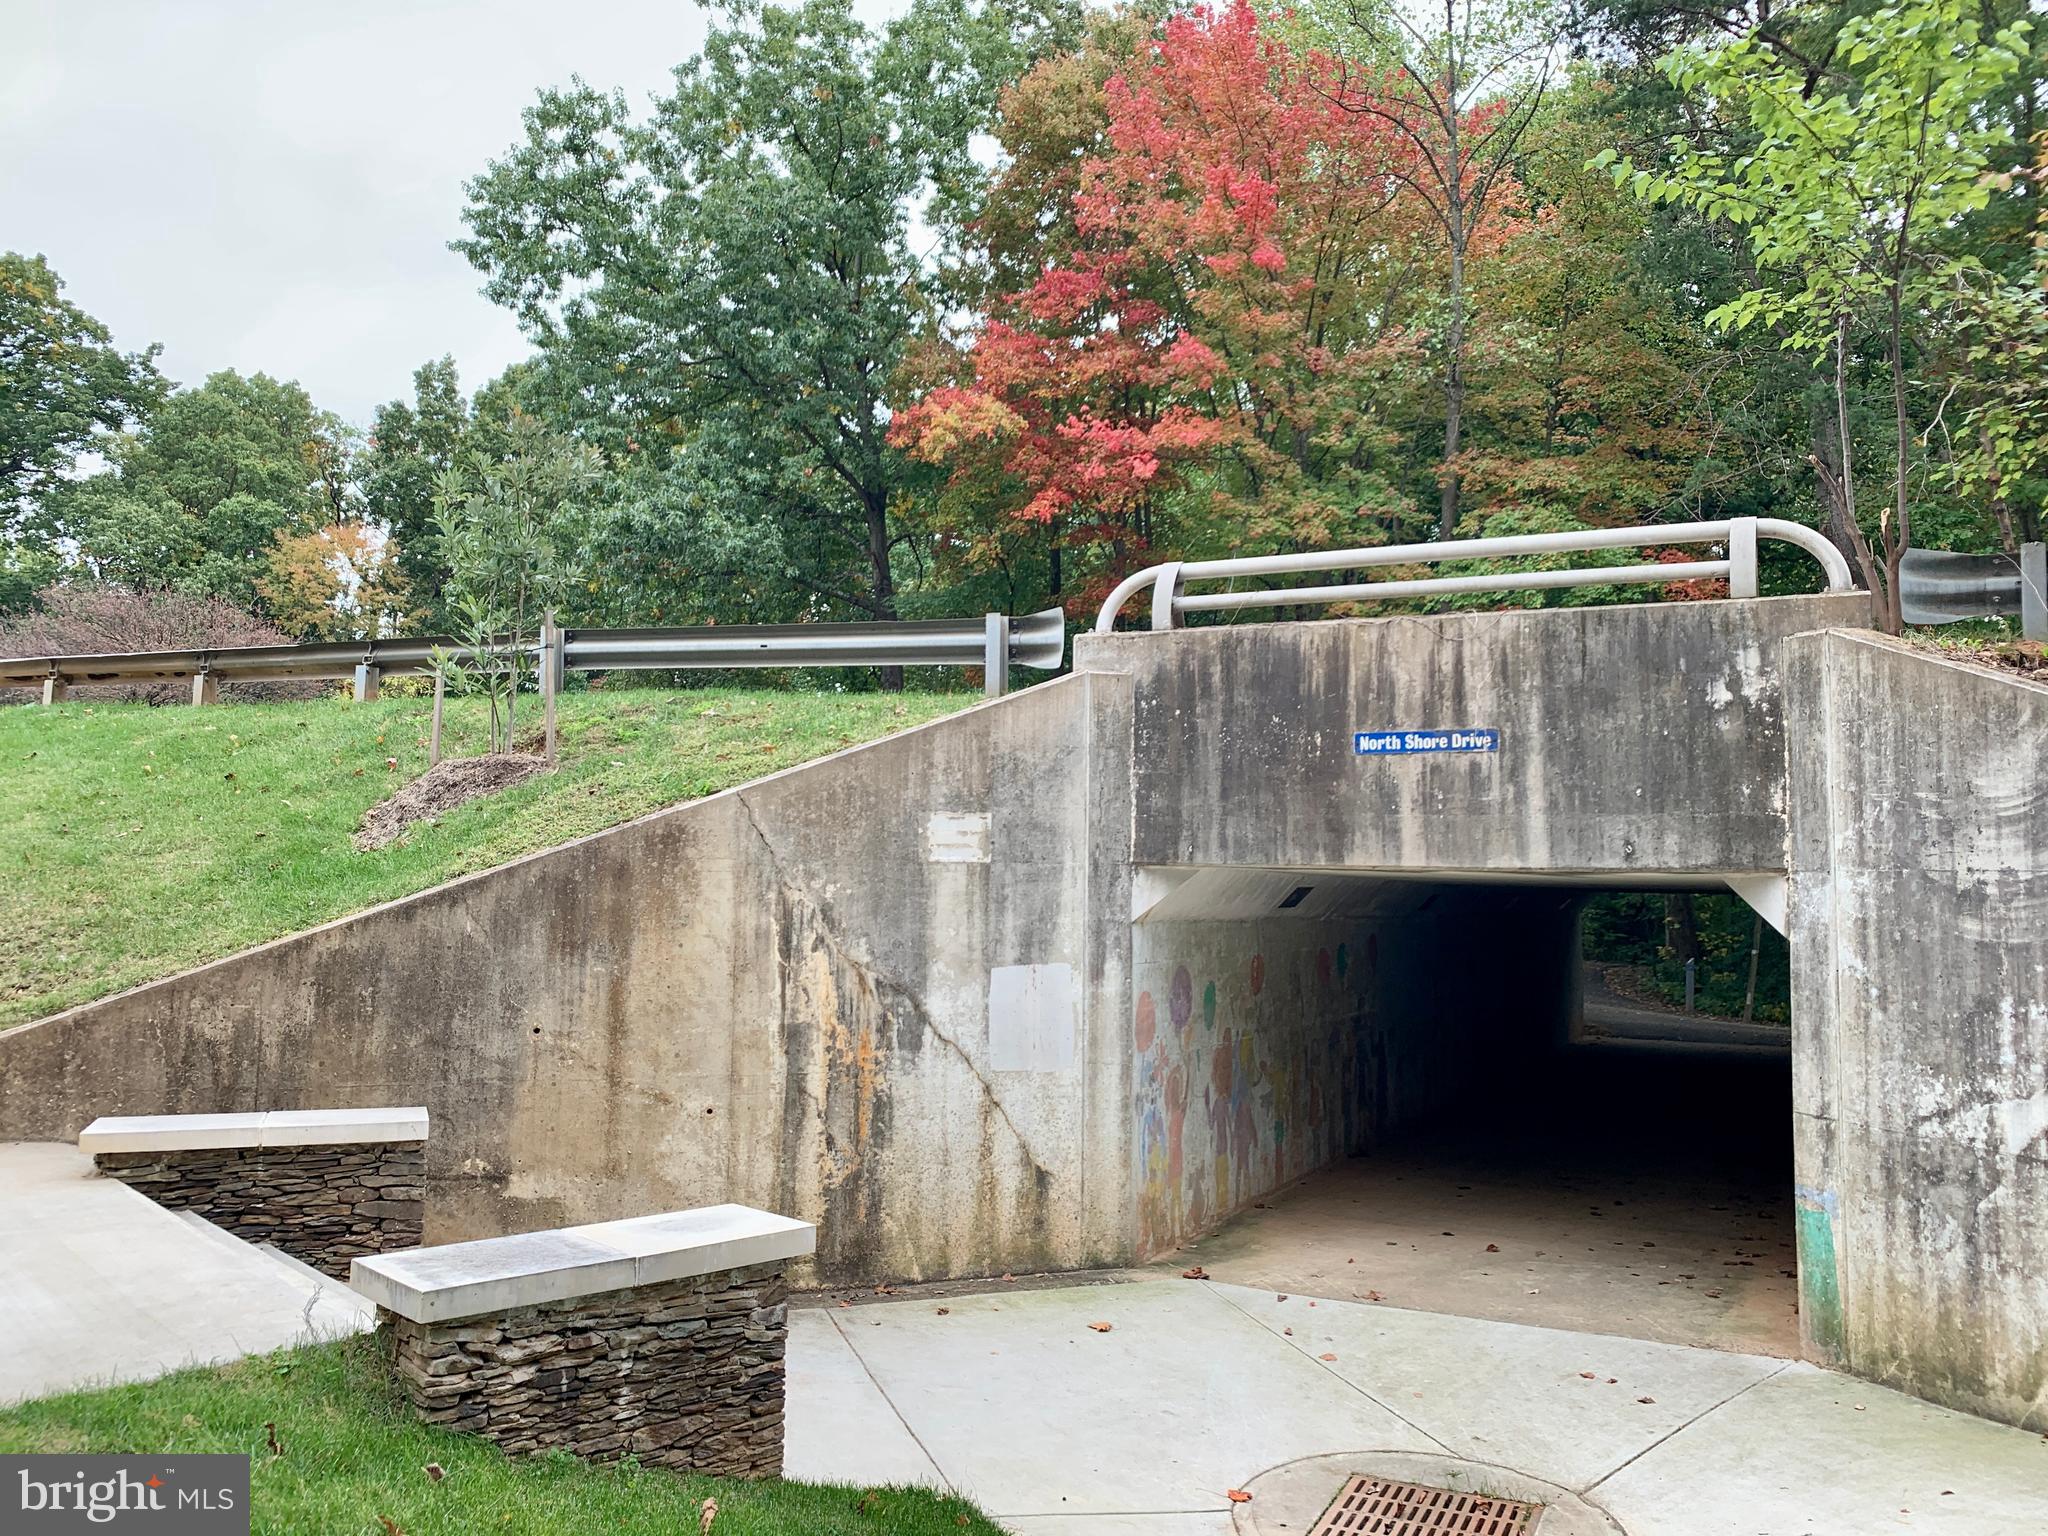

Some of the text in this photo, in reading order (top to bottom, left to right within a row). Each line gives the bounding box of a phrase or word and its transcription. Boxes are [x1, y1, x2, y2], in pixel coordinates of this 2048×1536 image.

[1359, 733, 1491, 751] North Shore Drive
